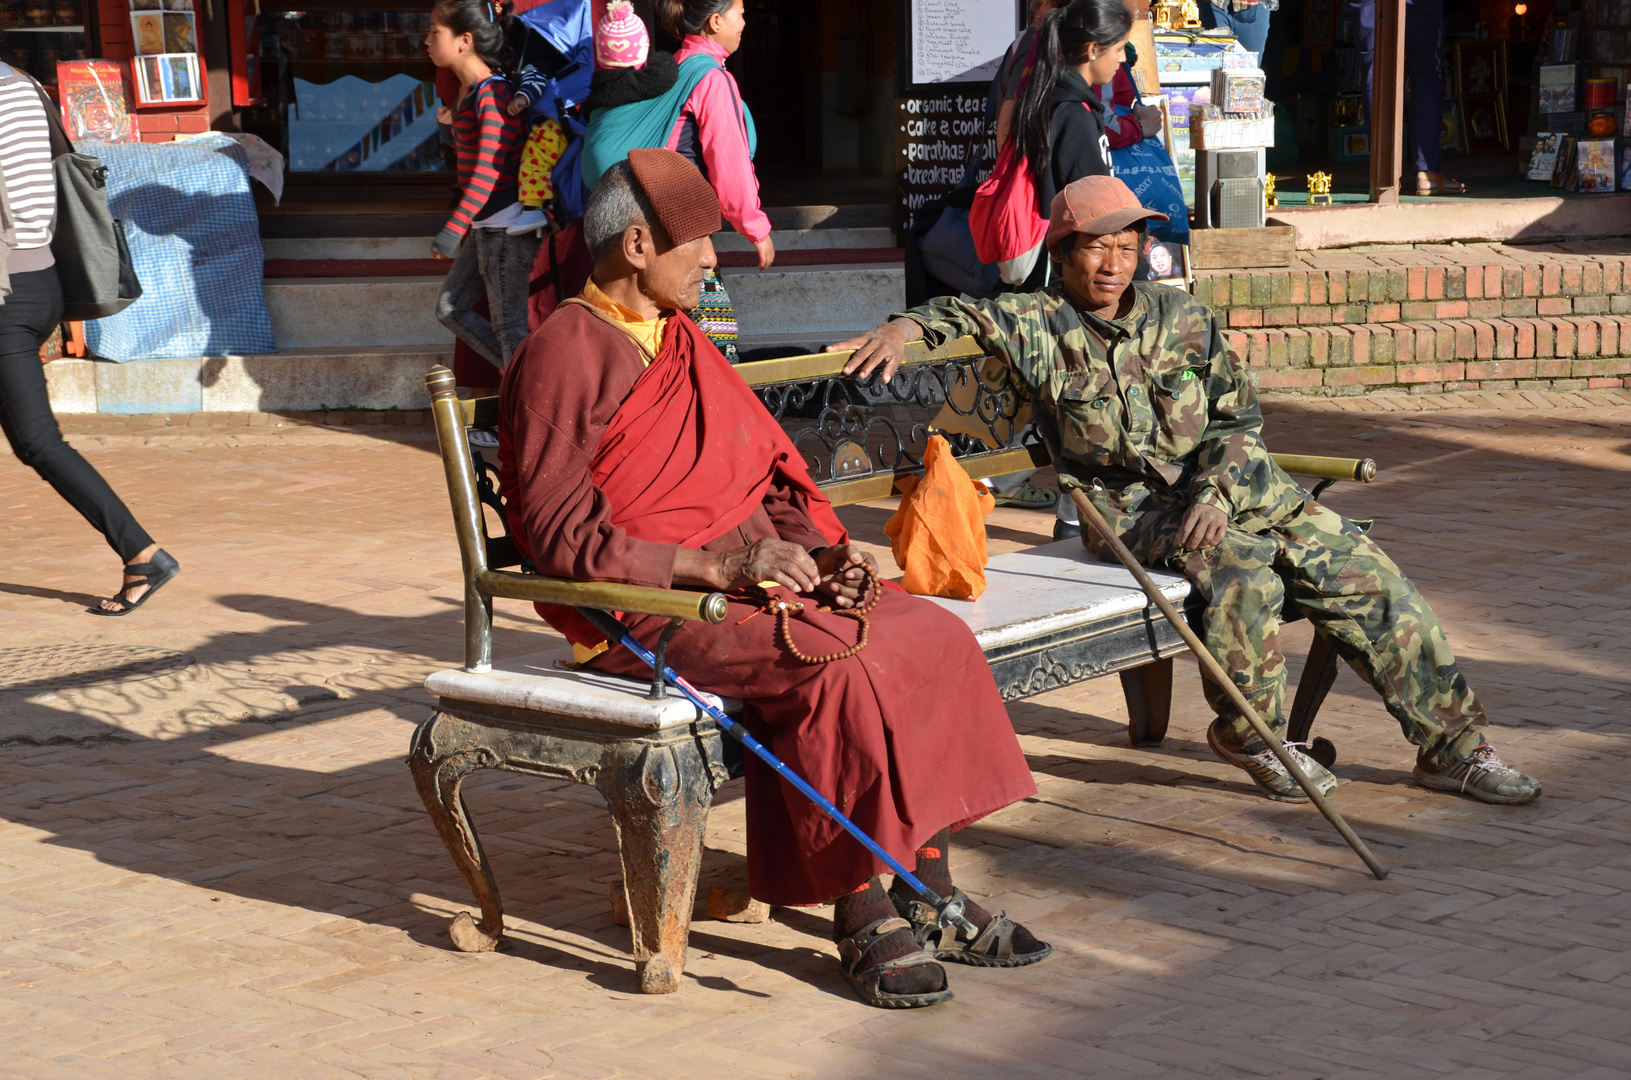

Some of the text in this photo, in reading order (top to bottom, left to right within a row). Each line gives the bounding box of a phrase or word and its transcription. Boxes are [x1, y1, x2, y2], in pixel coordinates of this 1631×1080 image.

[906, 95, 952, 114] organic
[956, 95, 979, 114] tea
[1133, 176, 1153, 198] ROXY
